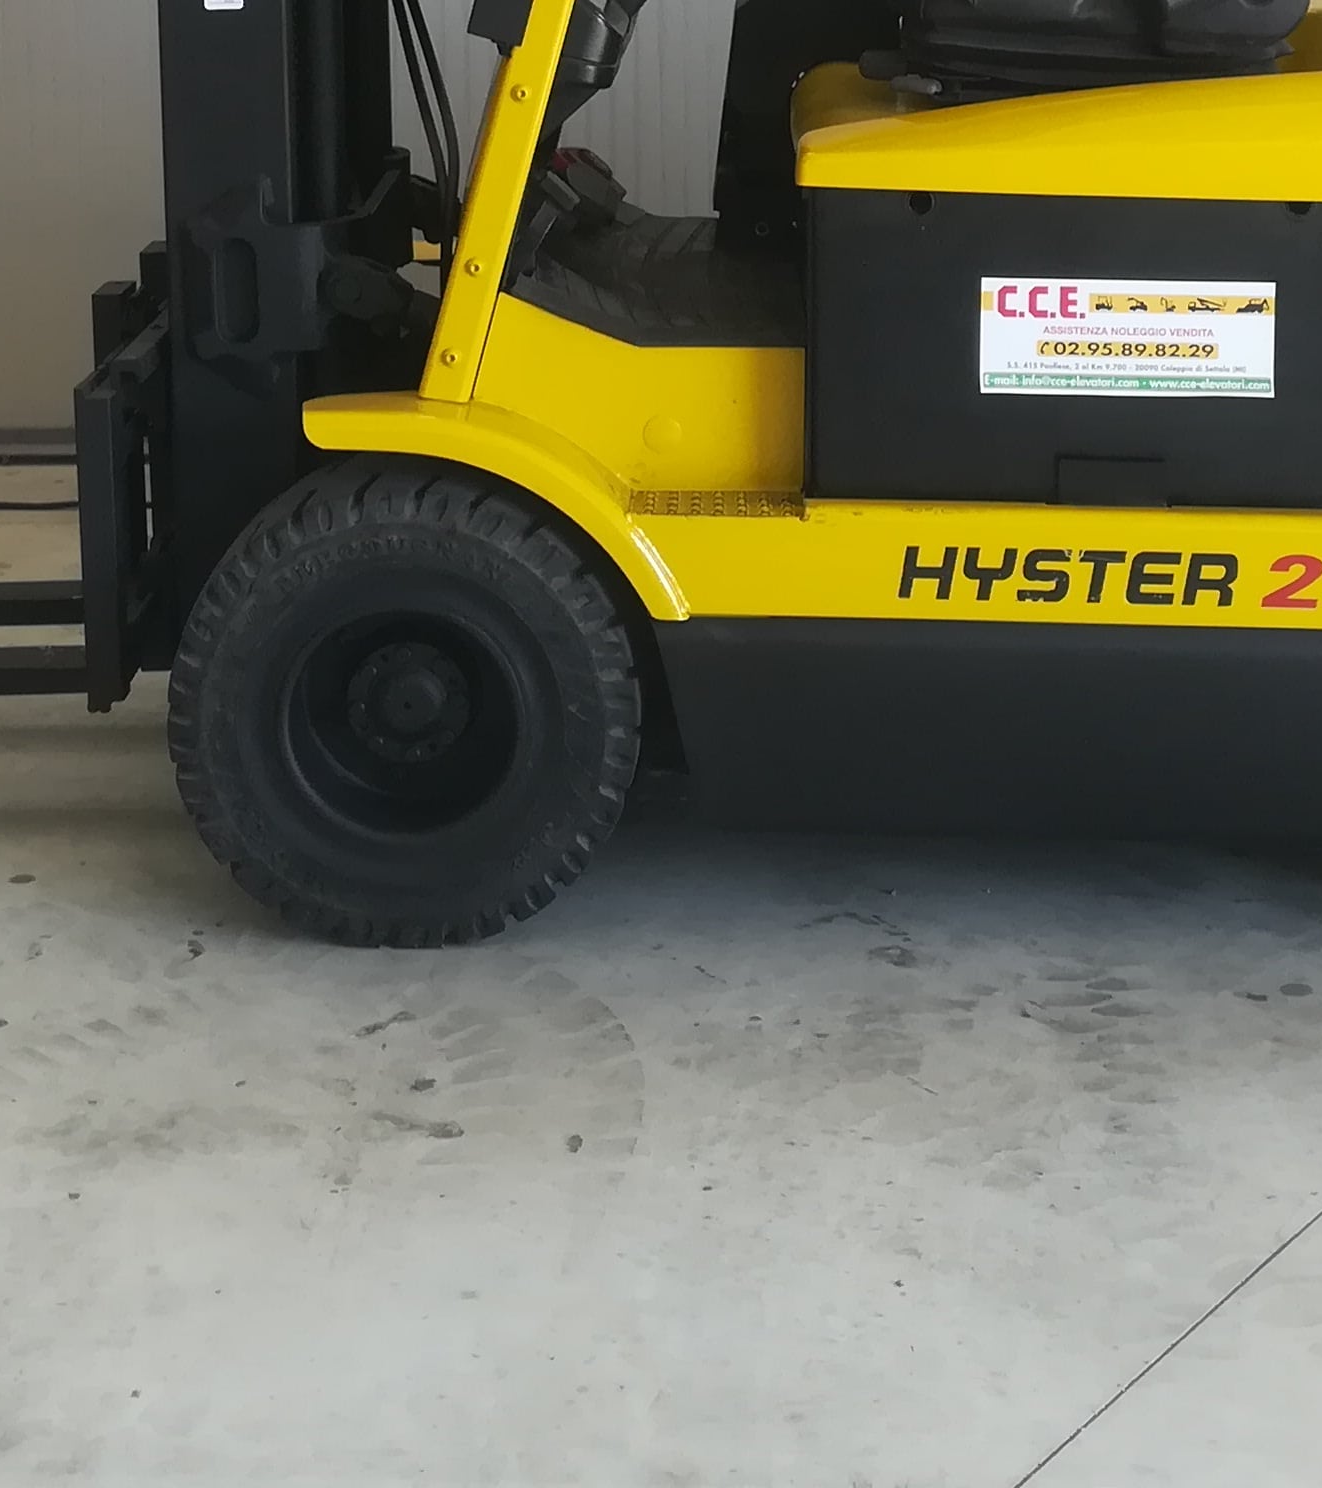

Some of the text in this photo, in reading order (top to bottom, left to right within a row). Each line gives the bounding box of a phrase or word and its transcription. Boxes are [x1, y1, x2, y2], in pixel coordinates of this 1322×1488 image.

[997, 285, 1086, 319] C.C.E.
[1043, 325, 1214, 338] ASSISTENZA NOLEGGIO VENDITA
[1054, 342, 1214, 358] 02.95.89.82.29
[984, 374, 1270, 391] E-mail: info@cce-elevatori.com www.cce-elevatori.com
[897, 545, 1239, 608] HYSTER
